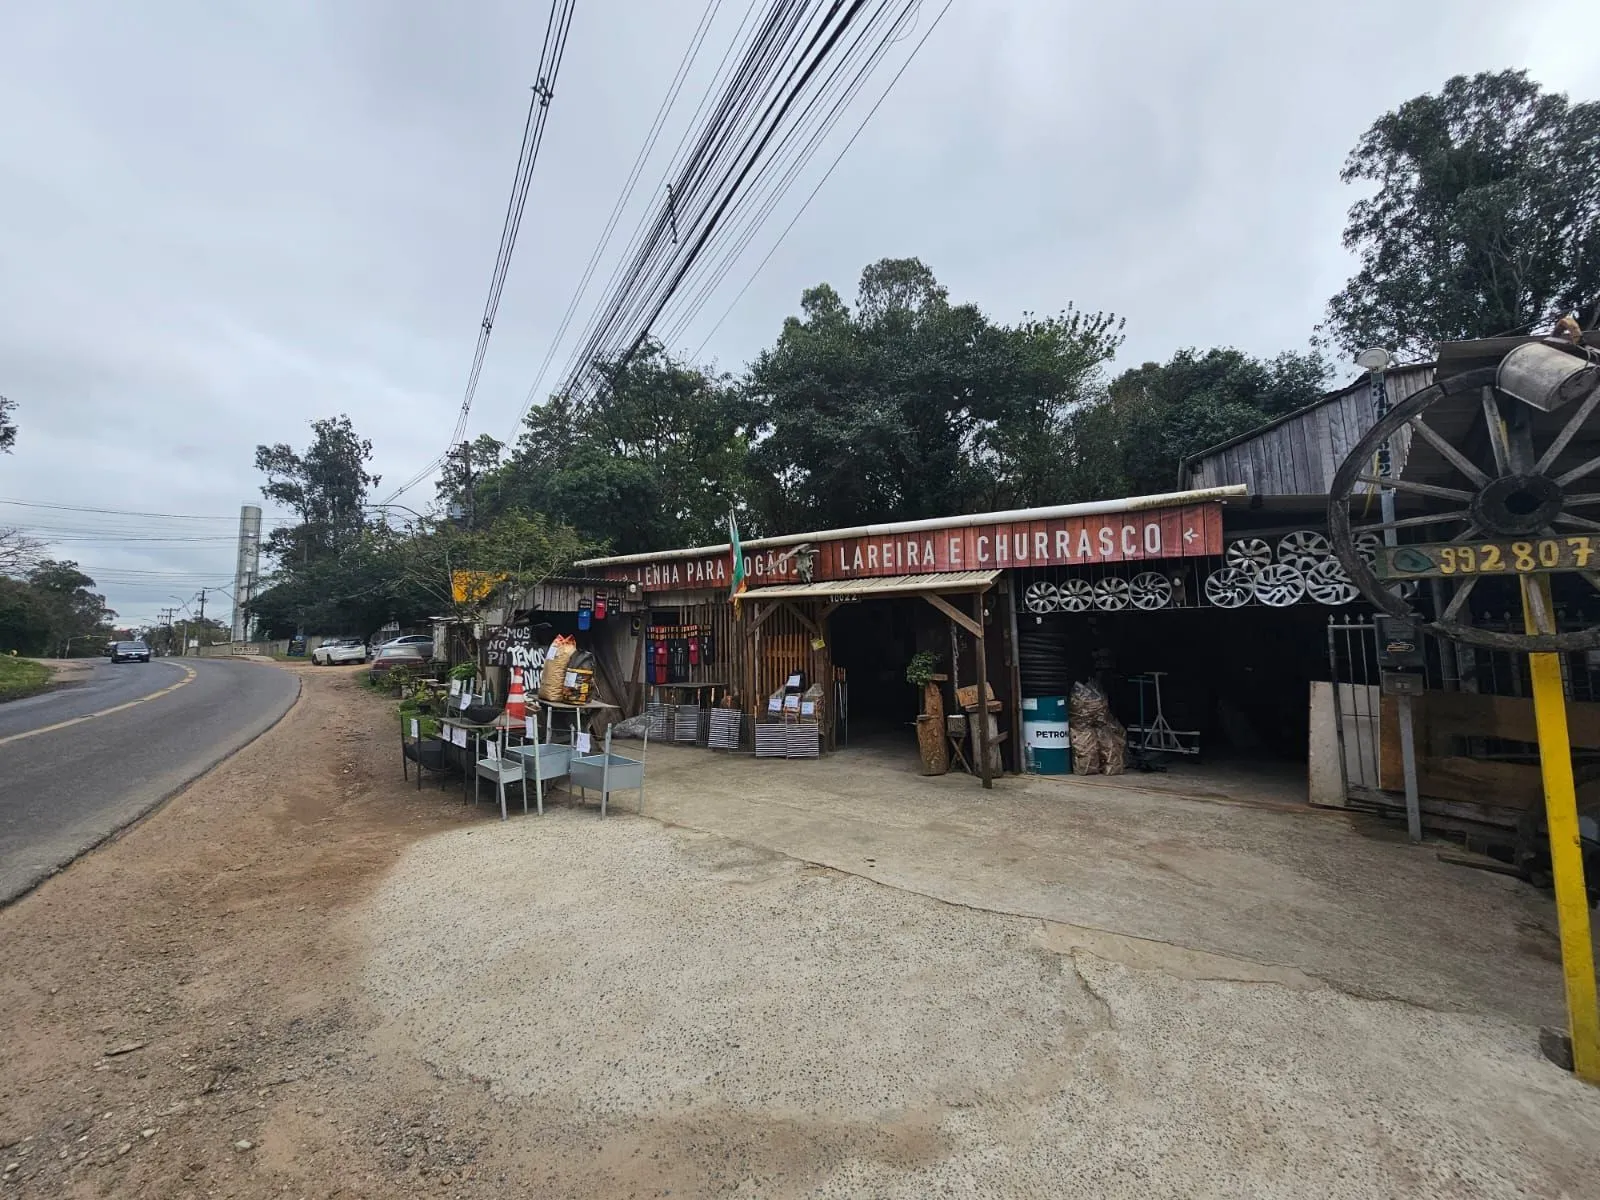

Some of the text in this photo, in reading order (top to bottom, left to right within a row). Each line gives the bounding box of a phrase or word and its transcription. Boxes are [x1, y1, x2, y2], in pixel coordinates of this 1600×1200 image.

[637, 563, 680, 586] LENHA
[687, 559, 725, 582] PARA
[840, 540, 935, 571] LAREIRA
[950, 537, 960, 563] E
[977, 523, 1161, 562] CHURRASCO
[1036, 730, 1068, 739] PETRO
